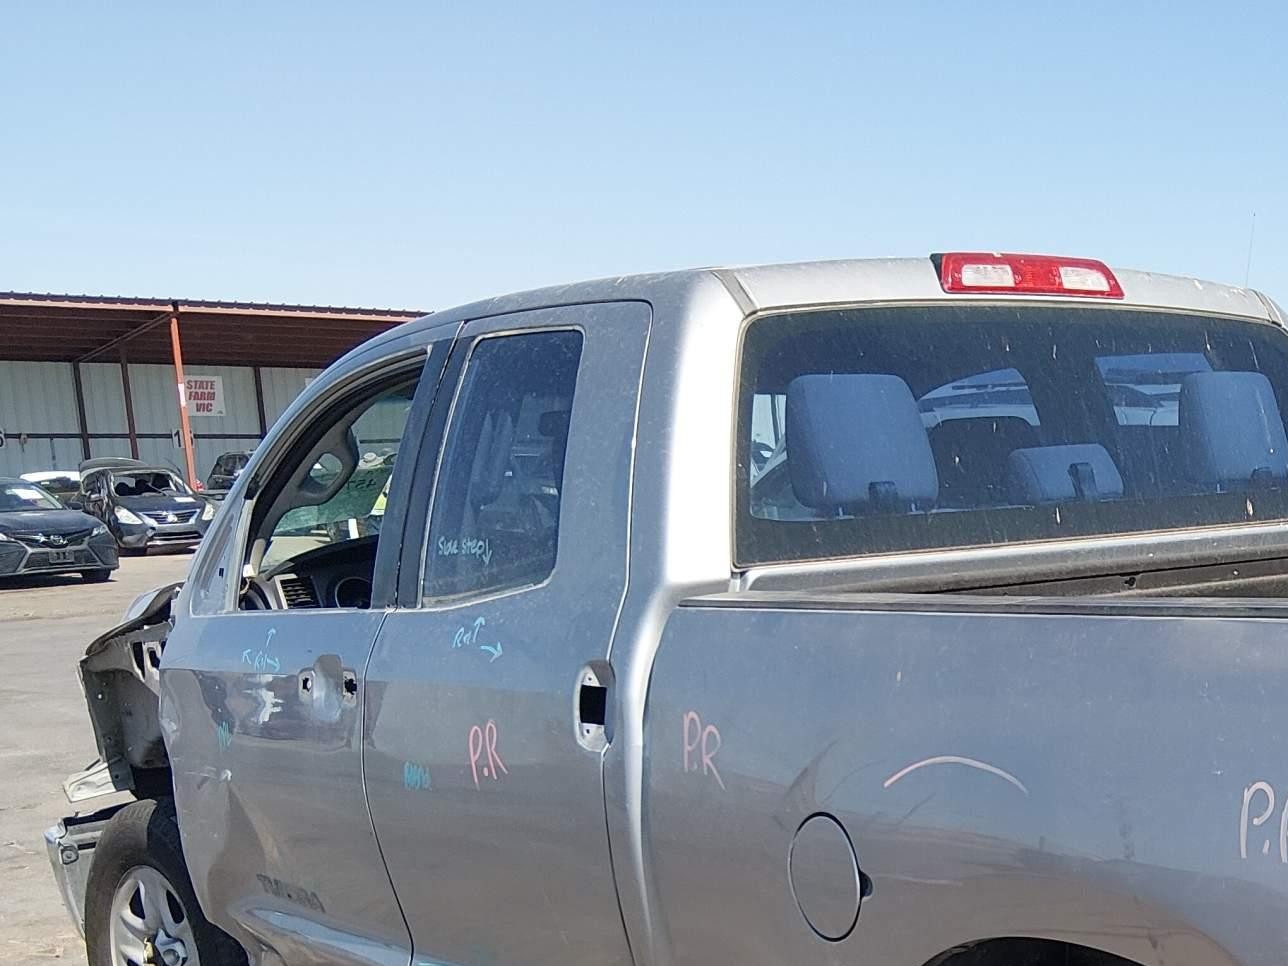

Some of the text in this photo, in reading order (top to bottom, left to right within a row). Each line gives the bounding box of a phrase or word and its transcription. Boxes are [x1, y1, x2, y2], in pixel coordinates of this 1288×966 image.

[186, 380, 216, 390] STATE
[188, 391, 216, 401] FARM
[195, 402, 214, 413] VIC
[468, 719, 509, 791] P.R
